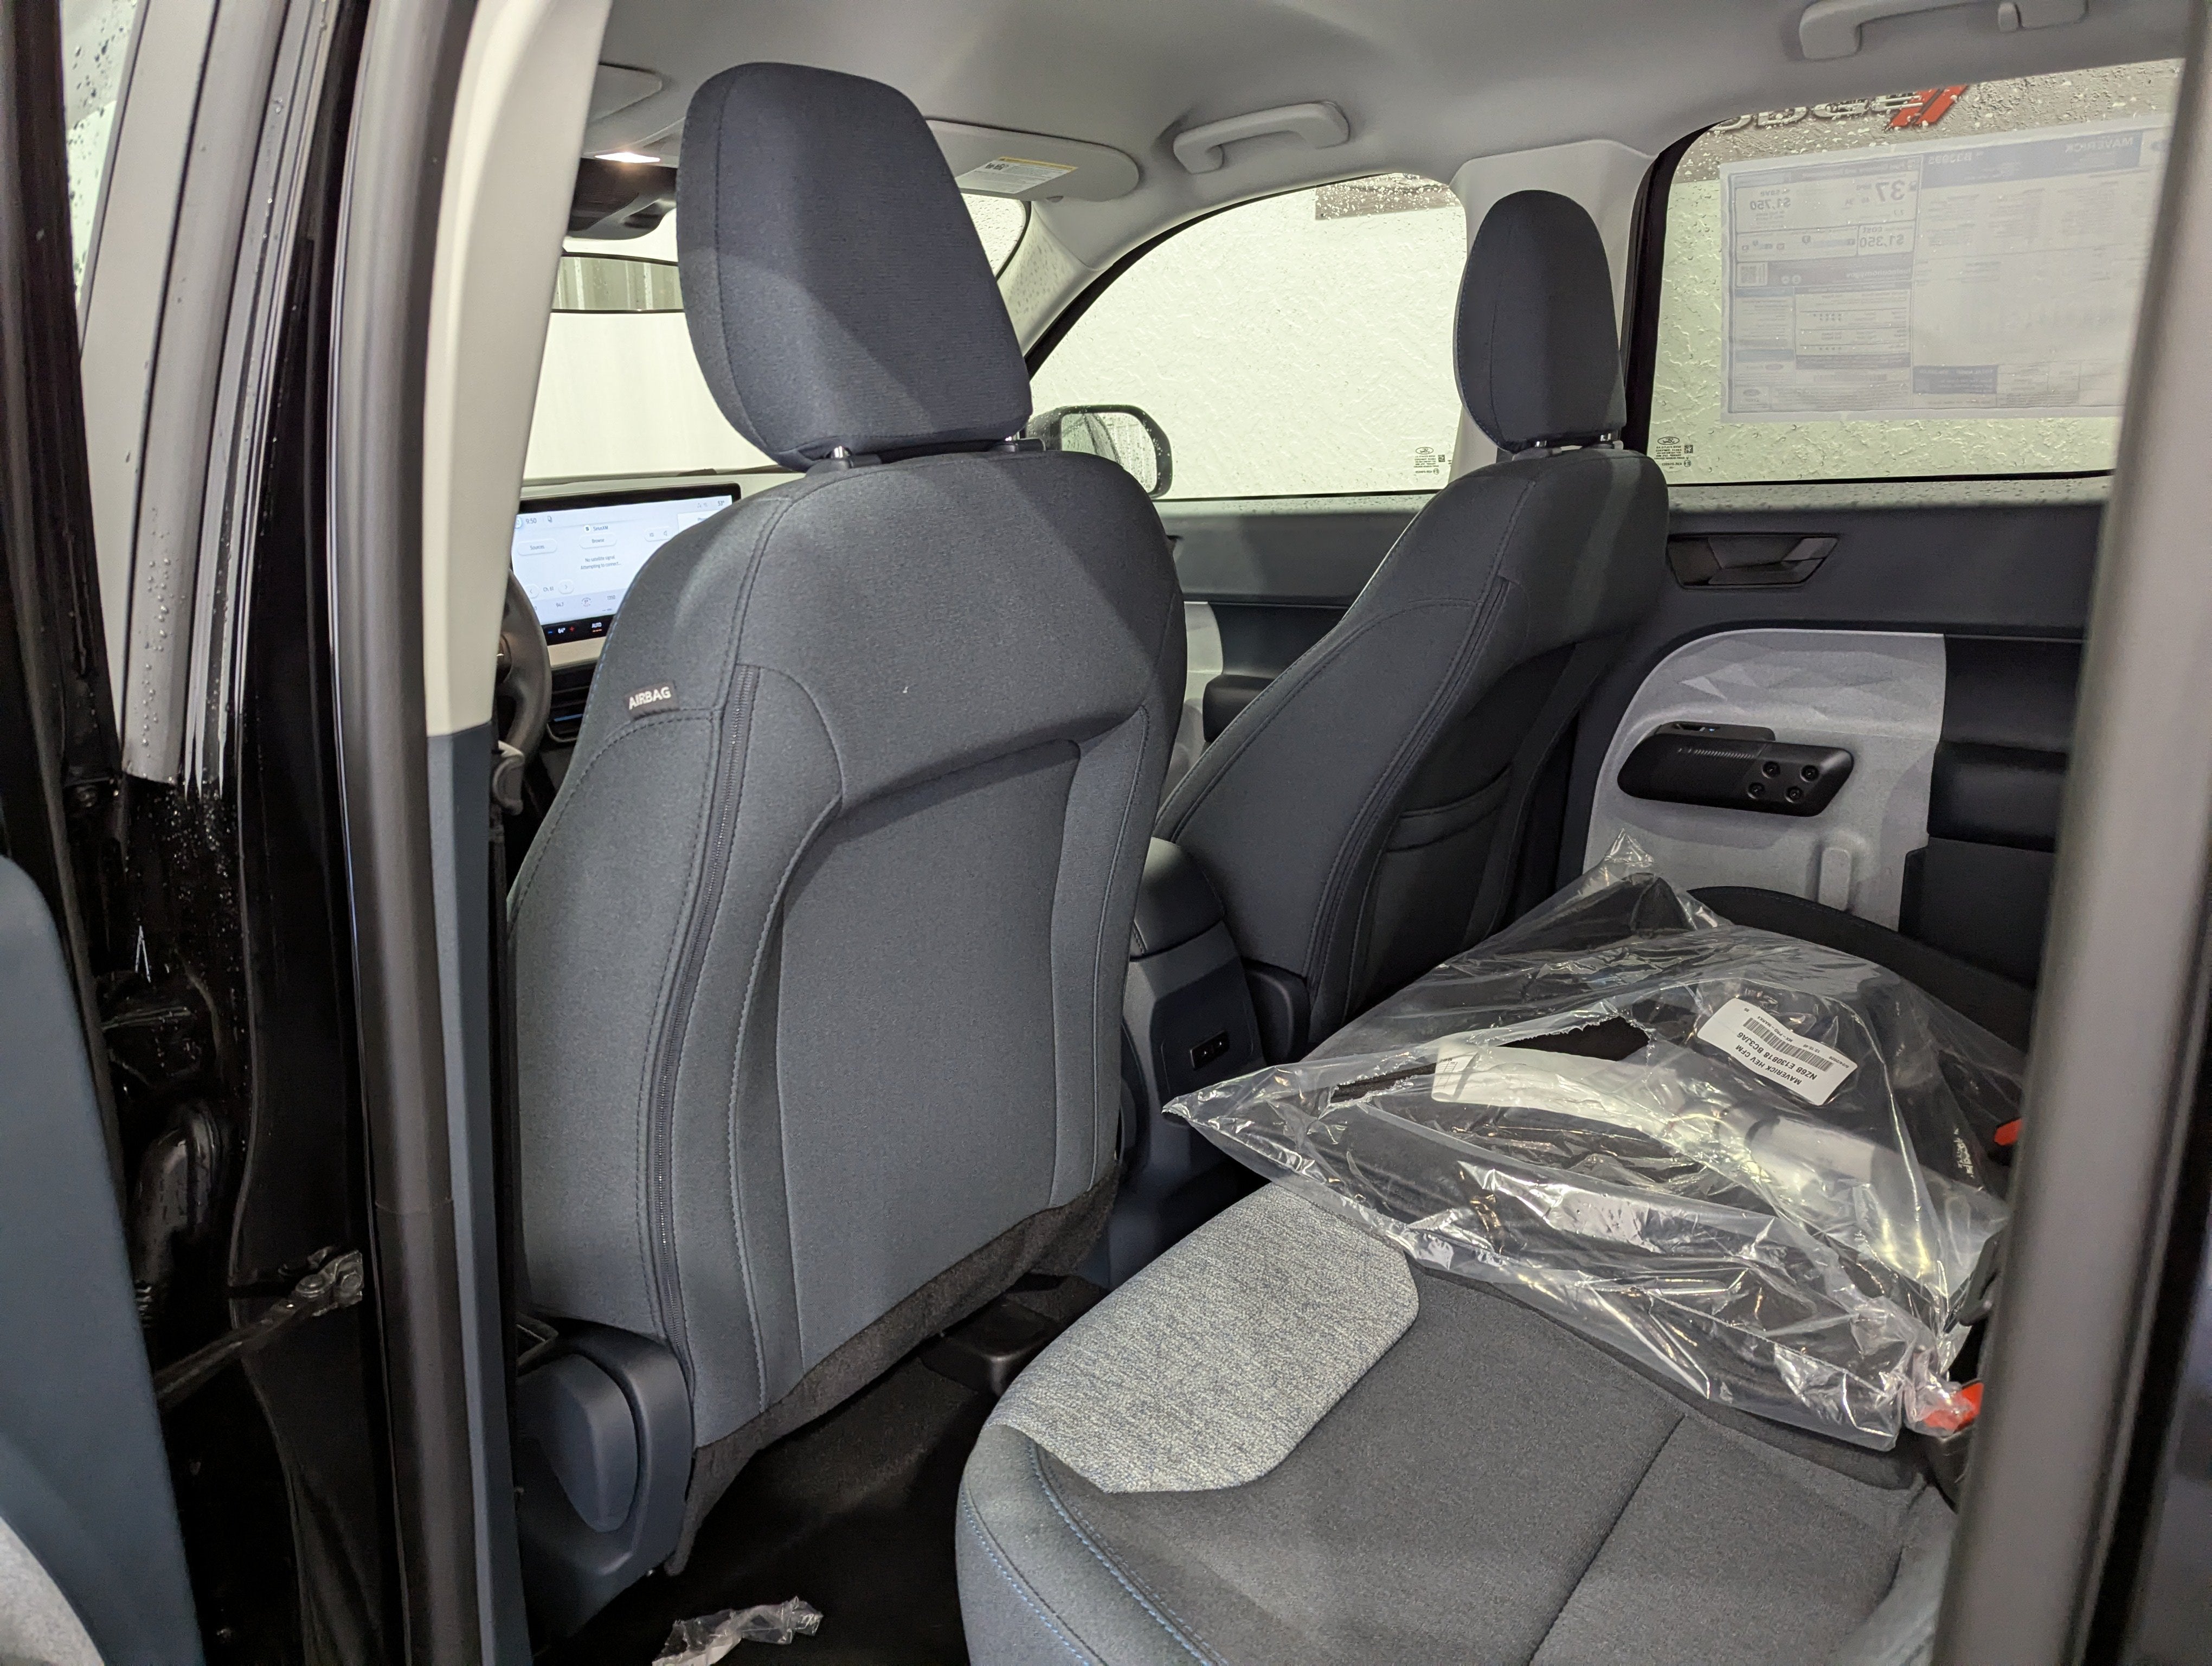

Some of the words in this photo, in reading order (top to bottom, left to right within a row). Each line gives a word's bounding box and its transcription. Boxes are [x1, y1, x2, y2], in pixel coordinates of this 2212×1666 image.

[628, 686, 672, 710] AIRBAG
[1737, 1031, 1765, 1052] BC3JA6
[1735, 1045, 1751, 1058] CFM
[1750, 1056, 1766, 1068] HEV
[1763, 1052, 1796, 1070] E130B18
[1765, 1066, 1802, 1085] MAVERICK
[1796, 1067, 1818, 1080] NZ6B
